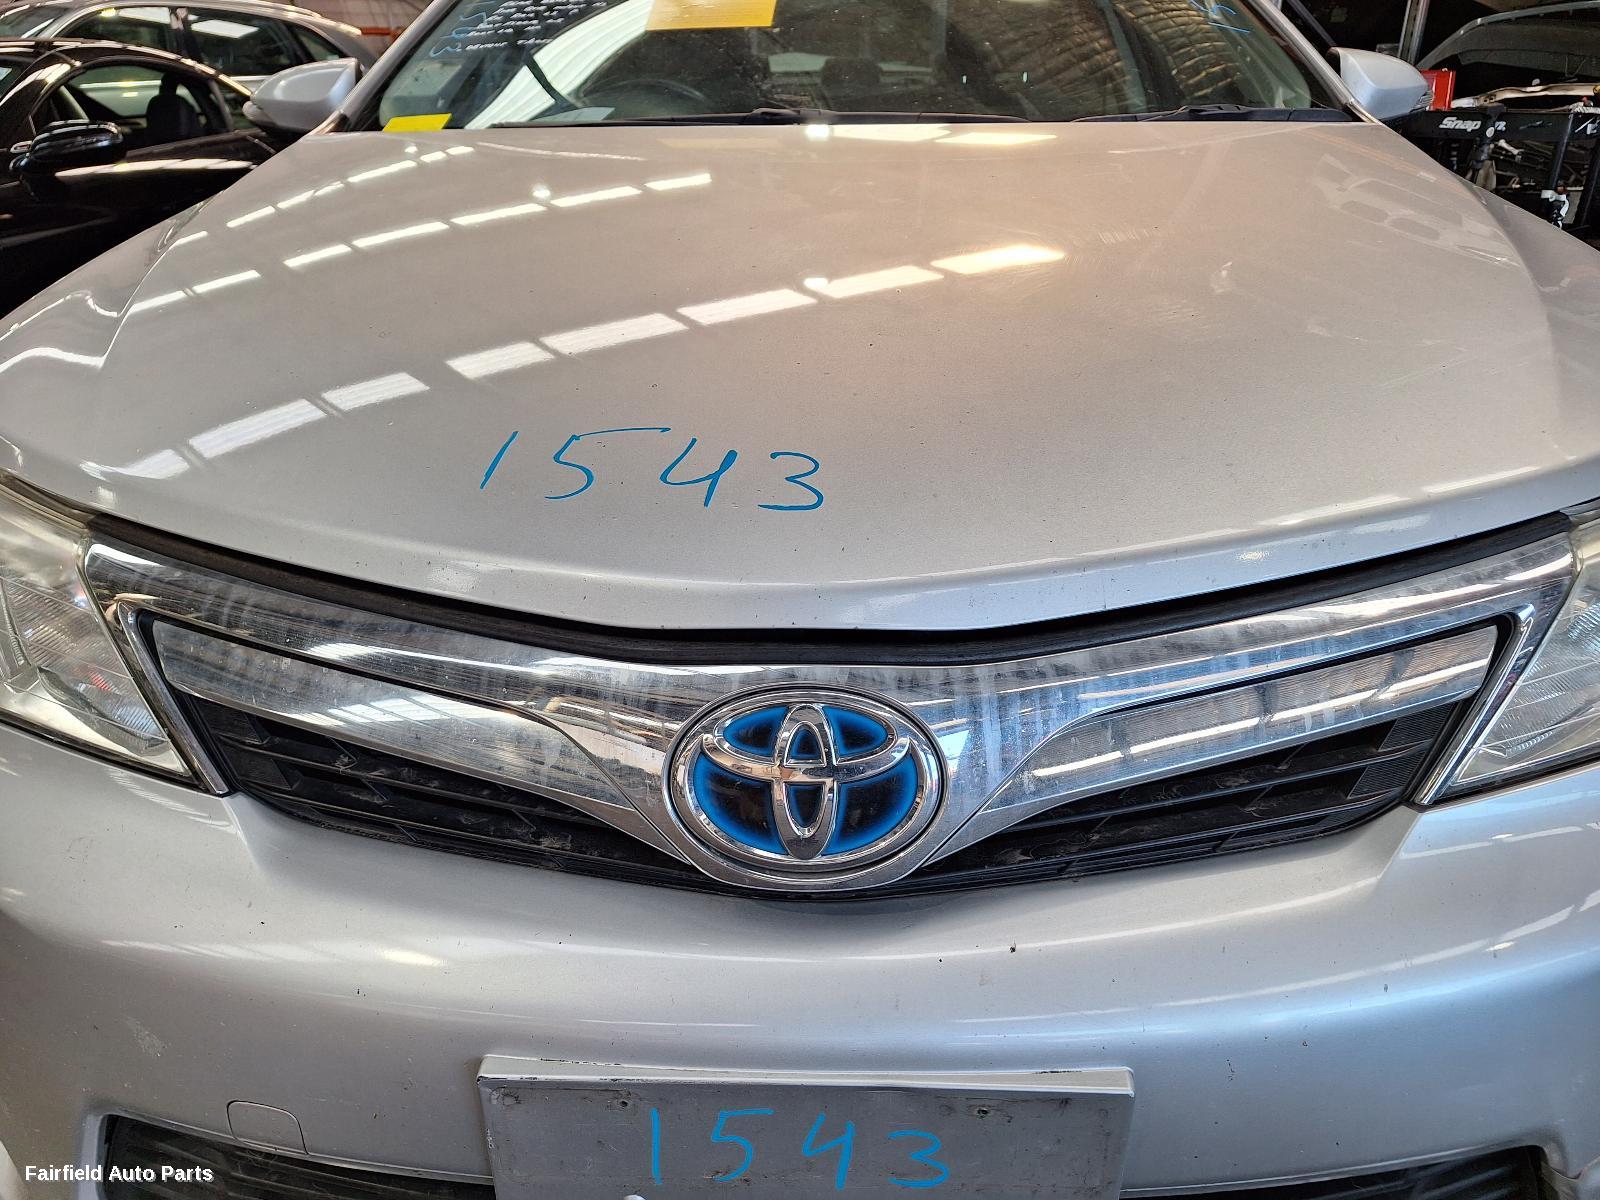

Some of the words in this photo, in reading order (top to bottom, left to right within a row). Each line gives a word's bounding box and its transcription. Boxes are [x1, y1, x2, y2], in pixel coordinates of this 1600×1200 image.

[1439, 116, 1507, 132] Snapn
[480, 427, 824, 511] 1543
[651, 1108, 950, 1190] 1543
